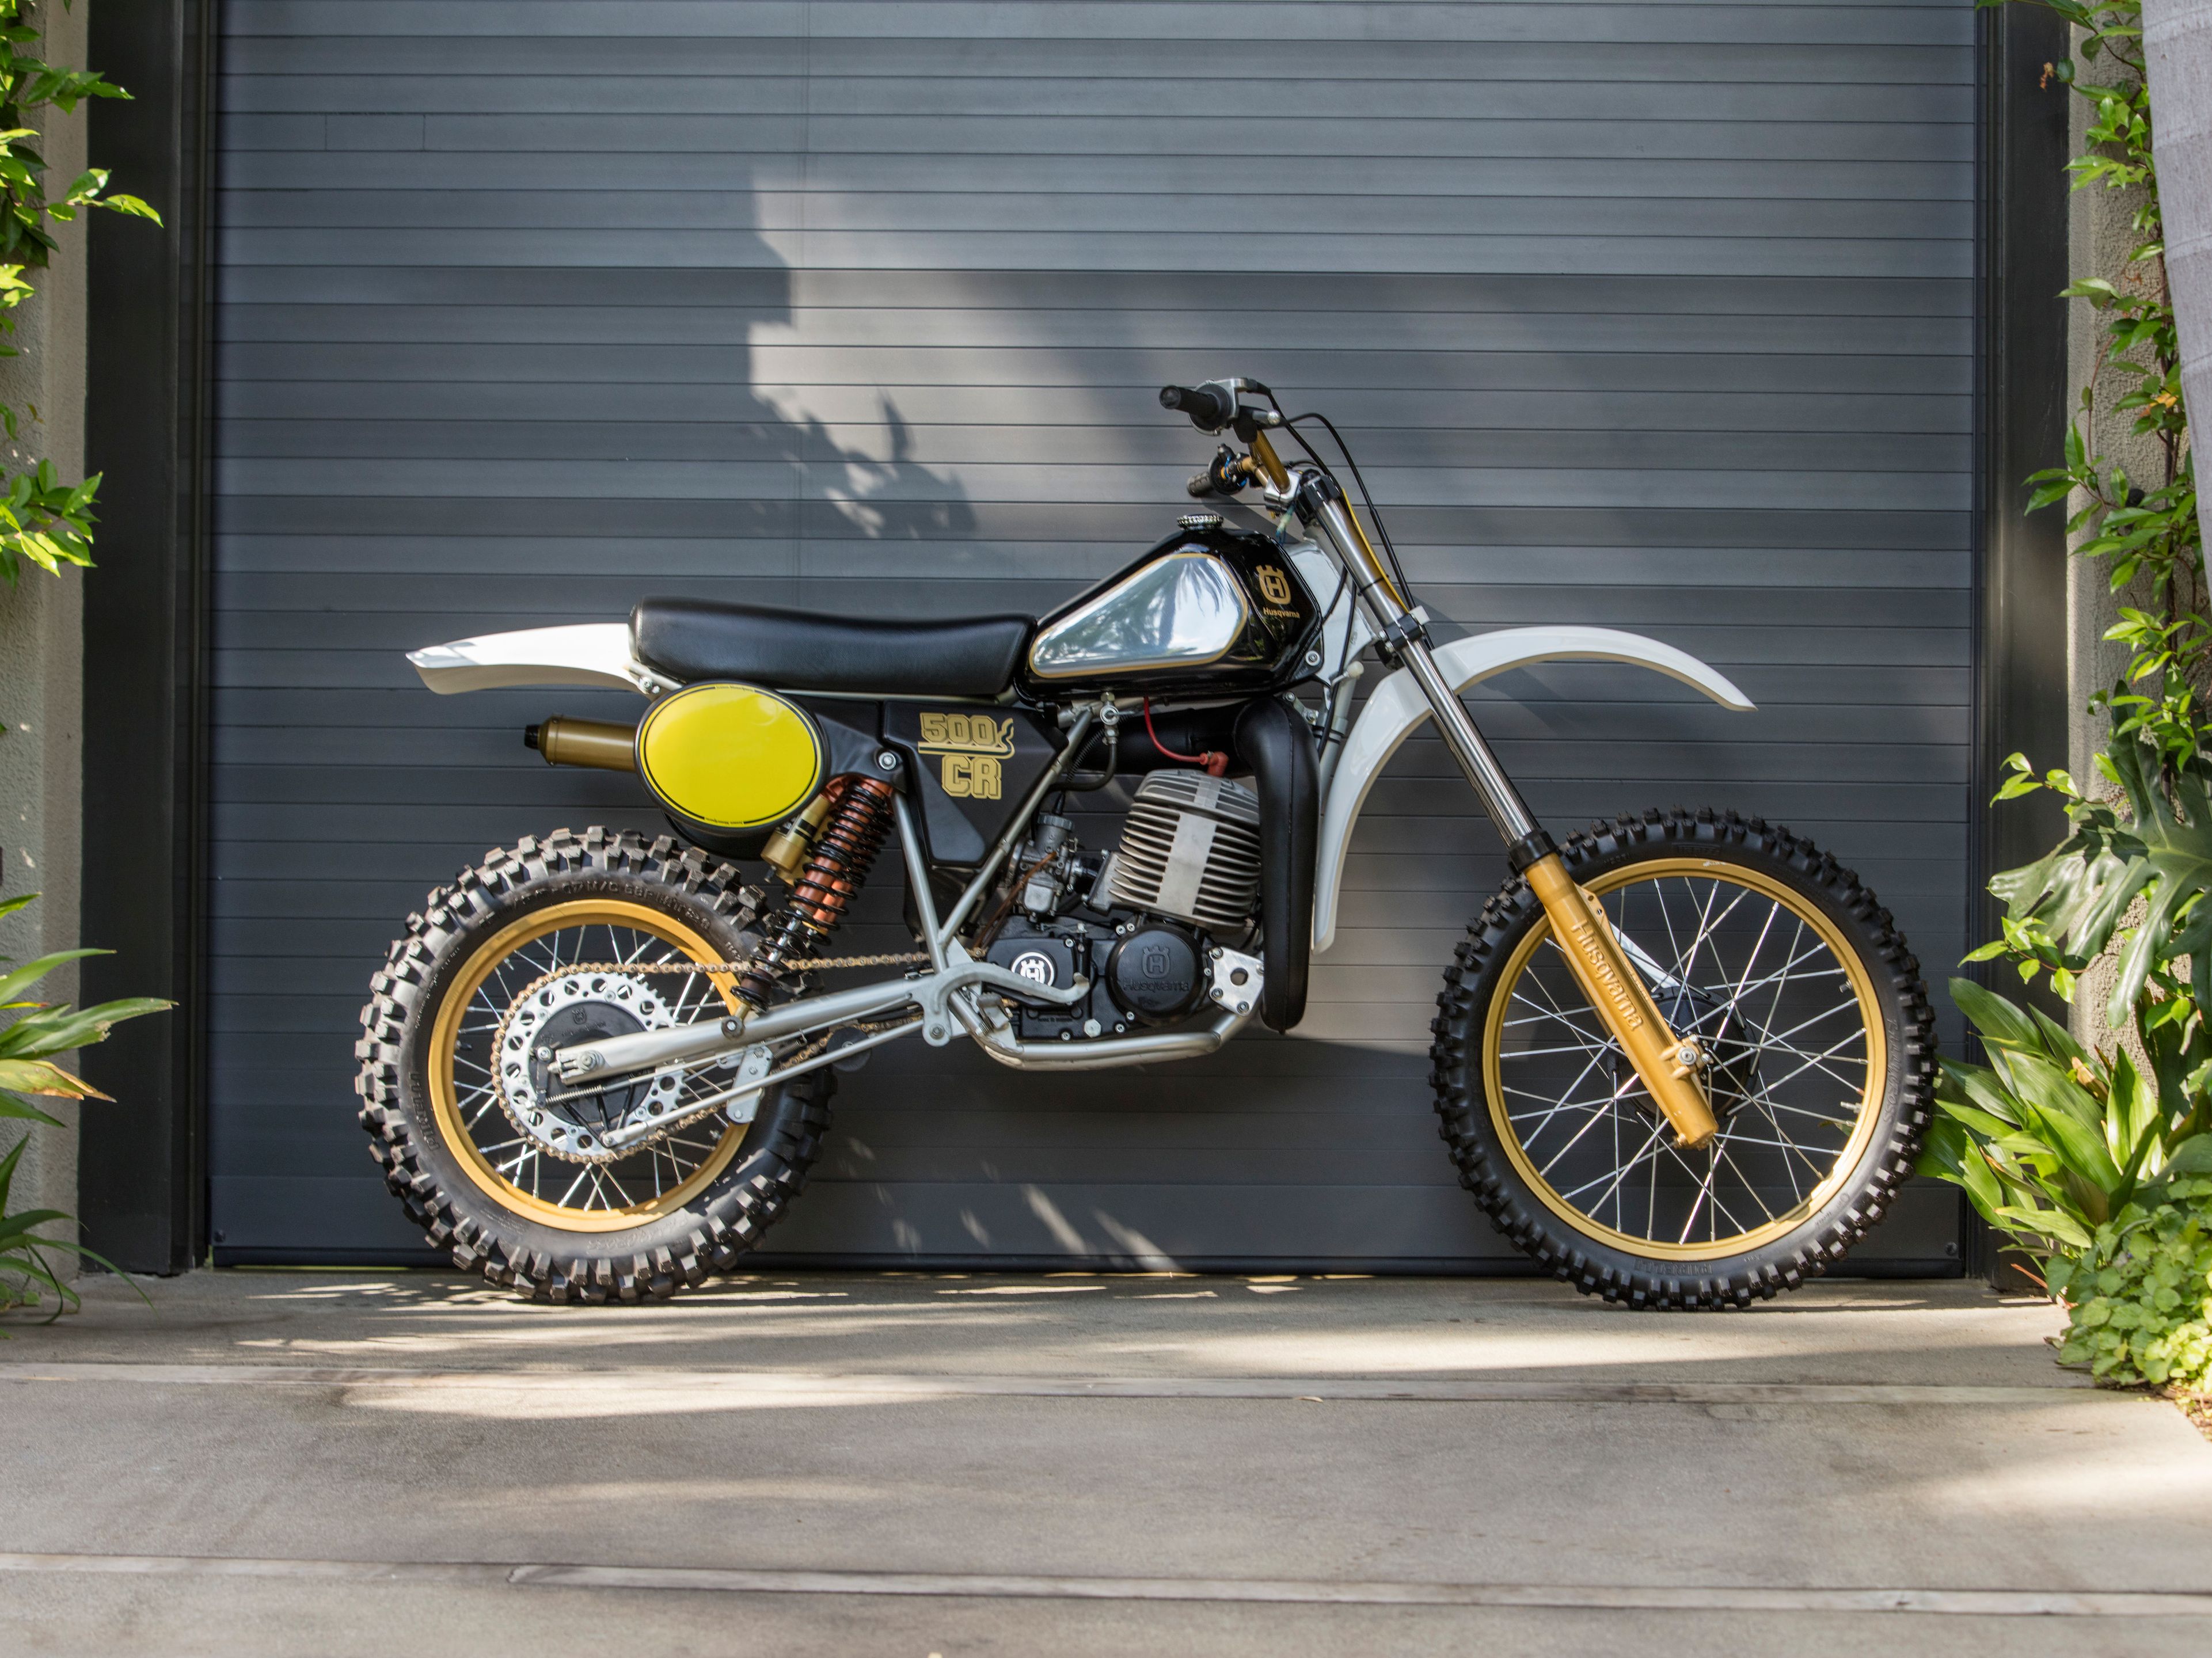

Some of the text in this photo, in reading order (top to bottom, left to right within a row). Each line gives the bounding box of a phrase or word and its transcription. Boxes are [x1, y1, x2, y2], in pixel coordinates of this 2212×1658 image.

[1263, 607, 1300, 619] Husqvarna
[919, 713, 997, 746] 500
[941, 754, 1002, 800] CR
[1122, 978, 1190, 993] Husqvarna
[1570, 919, 1644, 1031] Husqvarna
